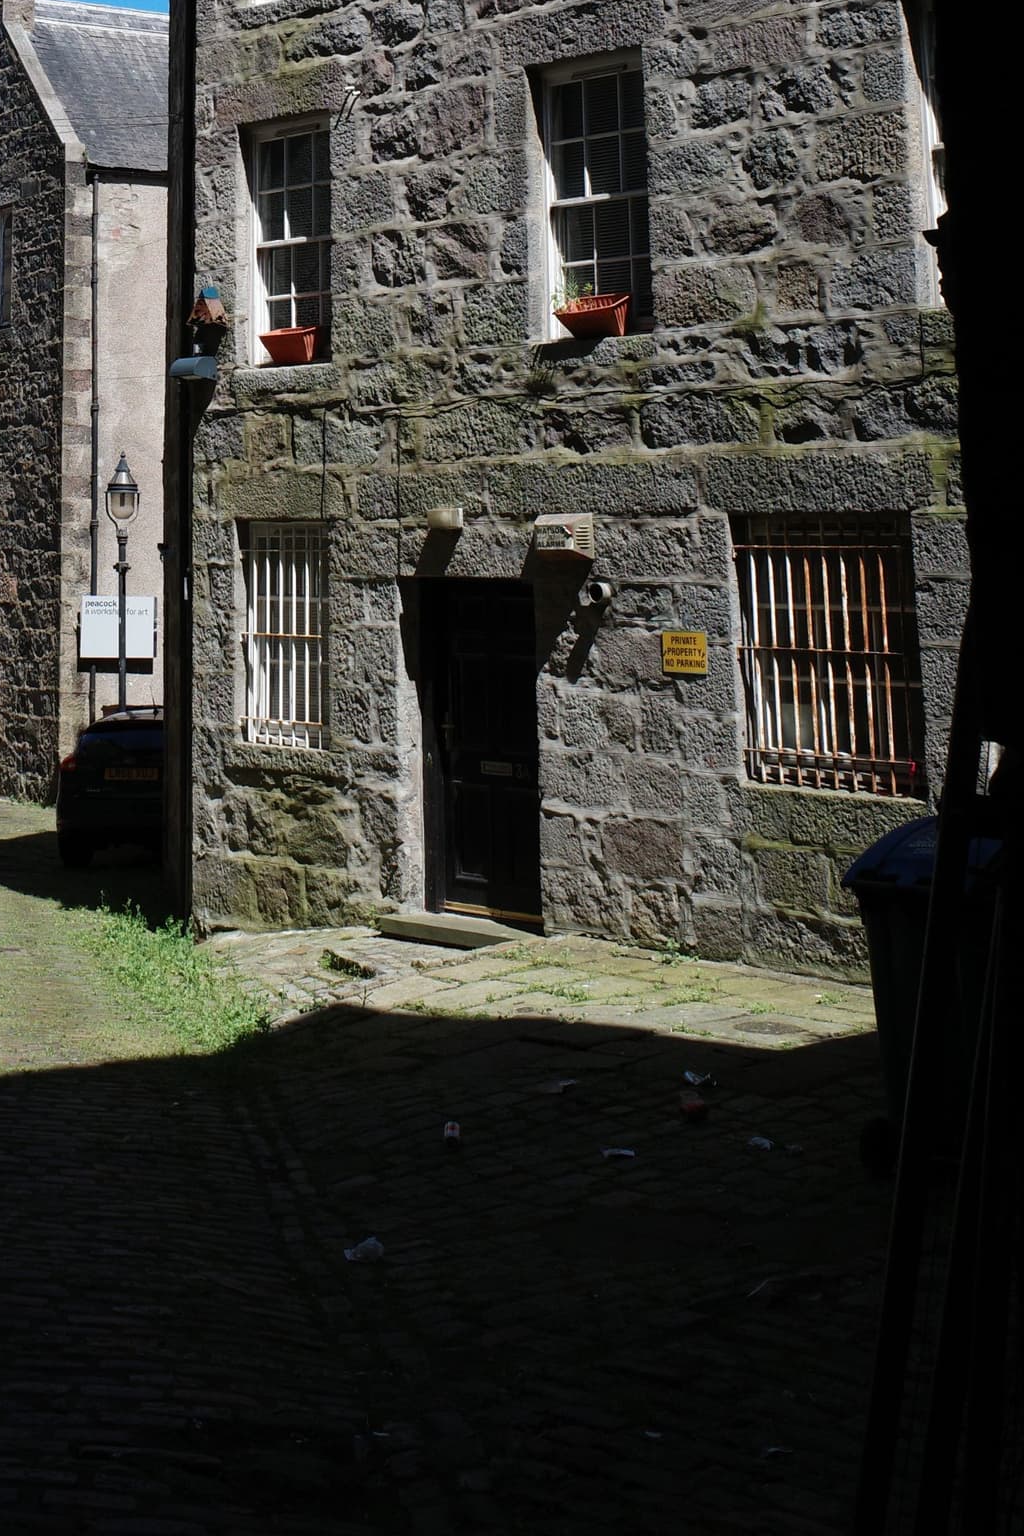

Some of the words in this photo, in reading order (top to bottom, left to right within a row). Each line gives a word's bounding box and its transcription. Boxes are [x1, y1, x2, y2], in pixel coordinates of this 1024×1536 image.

[85, 600, 117, 608] peacock
[671, 636, 697, 645] PRIVATE
[665, 658, 675, 667] NO
[677, 659, 706, 668] PARKING
